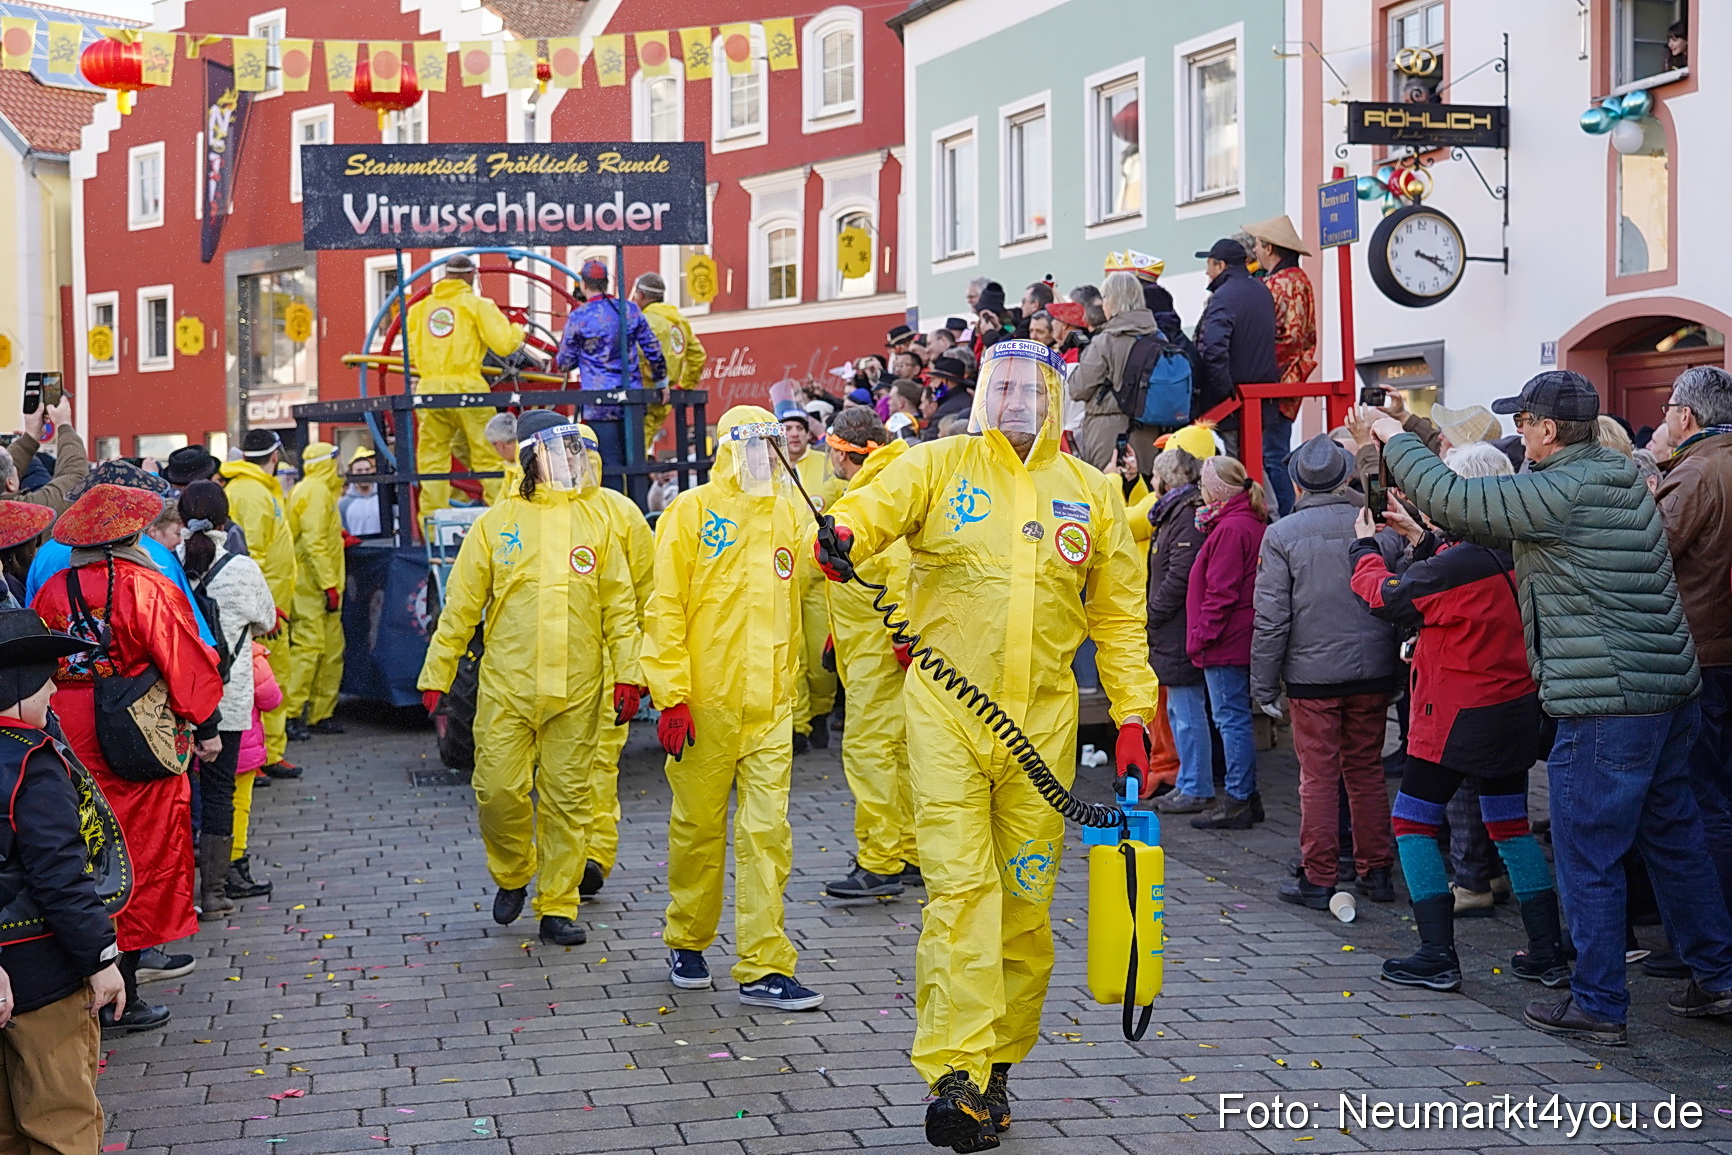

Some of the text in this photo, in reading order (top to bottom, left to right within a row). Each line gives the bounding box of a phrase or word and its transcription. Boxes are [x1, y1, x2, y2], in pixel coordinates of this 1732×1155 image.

[1364, 108, 1491, 130] RÖHLICH
[344, 152, 670, 178] Stammtisch Fröhliche Runde
[343, 190, 671, 235] Virusschleuder
[998, 342, 1046, 355] FACE SHIELD
[714, 346, 756, 379] Erlebnis
